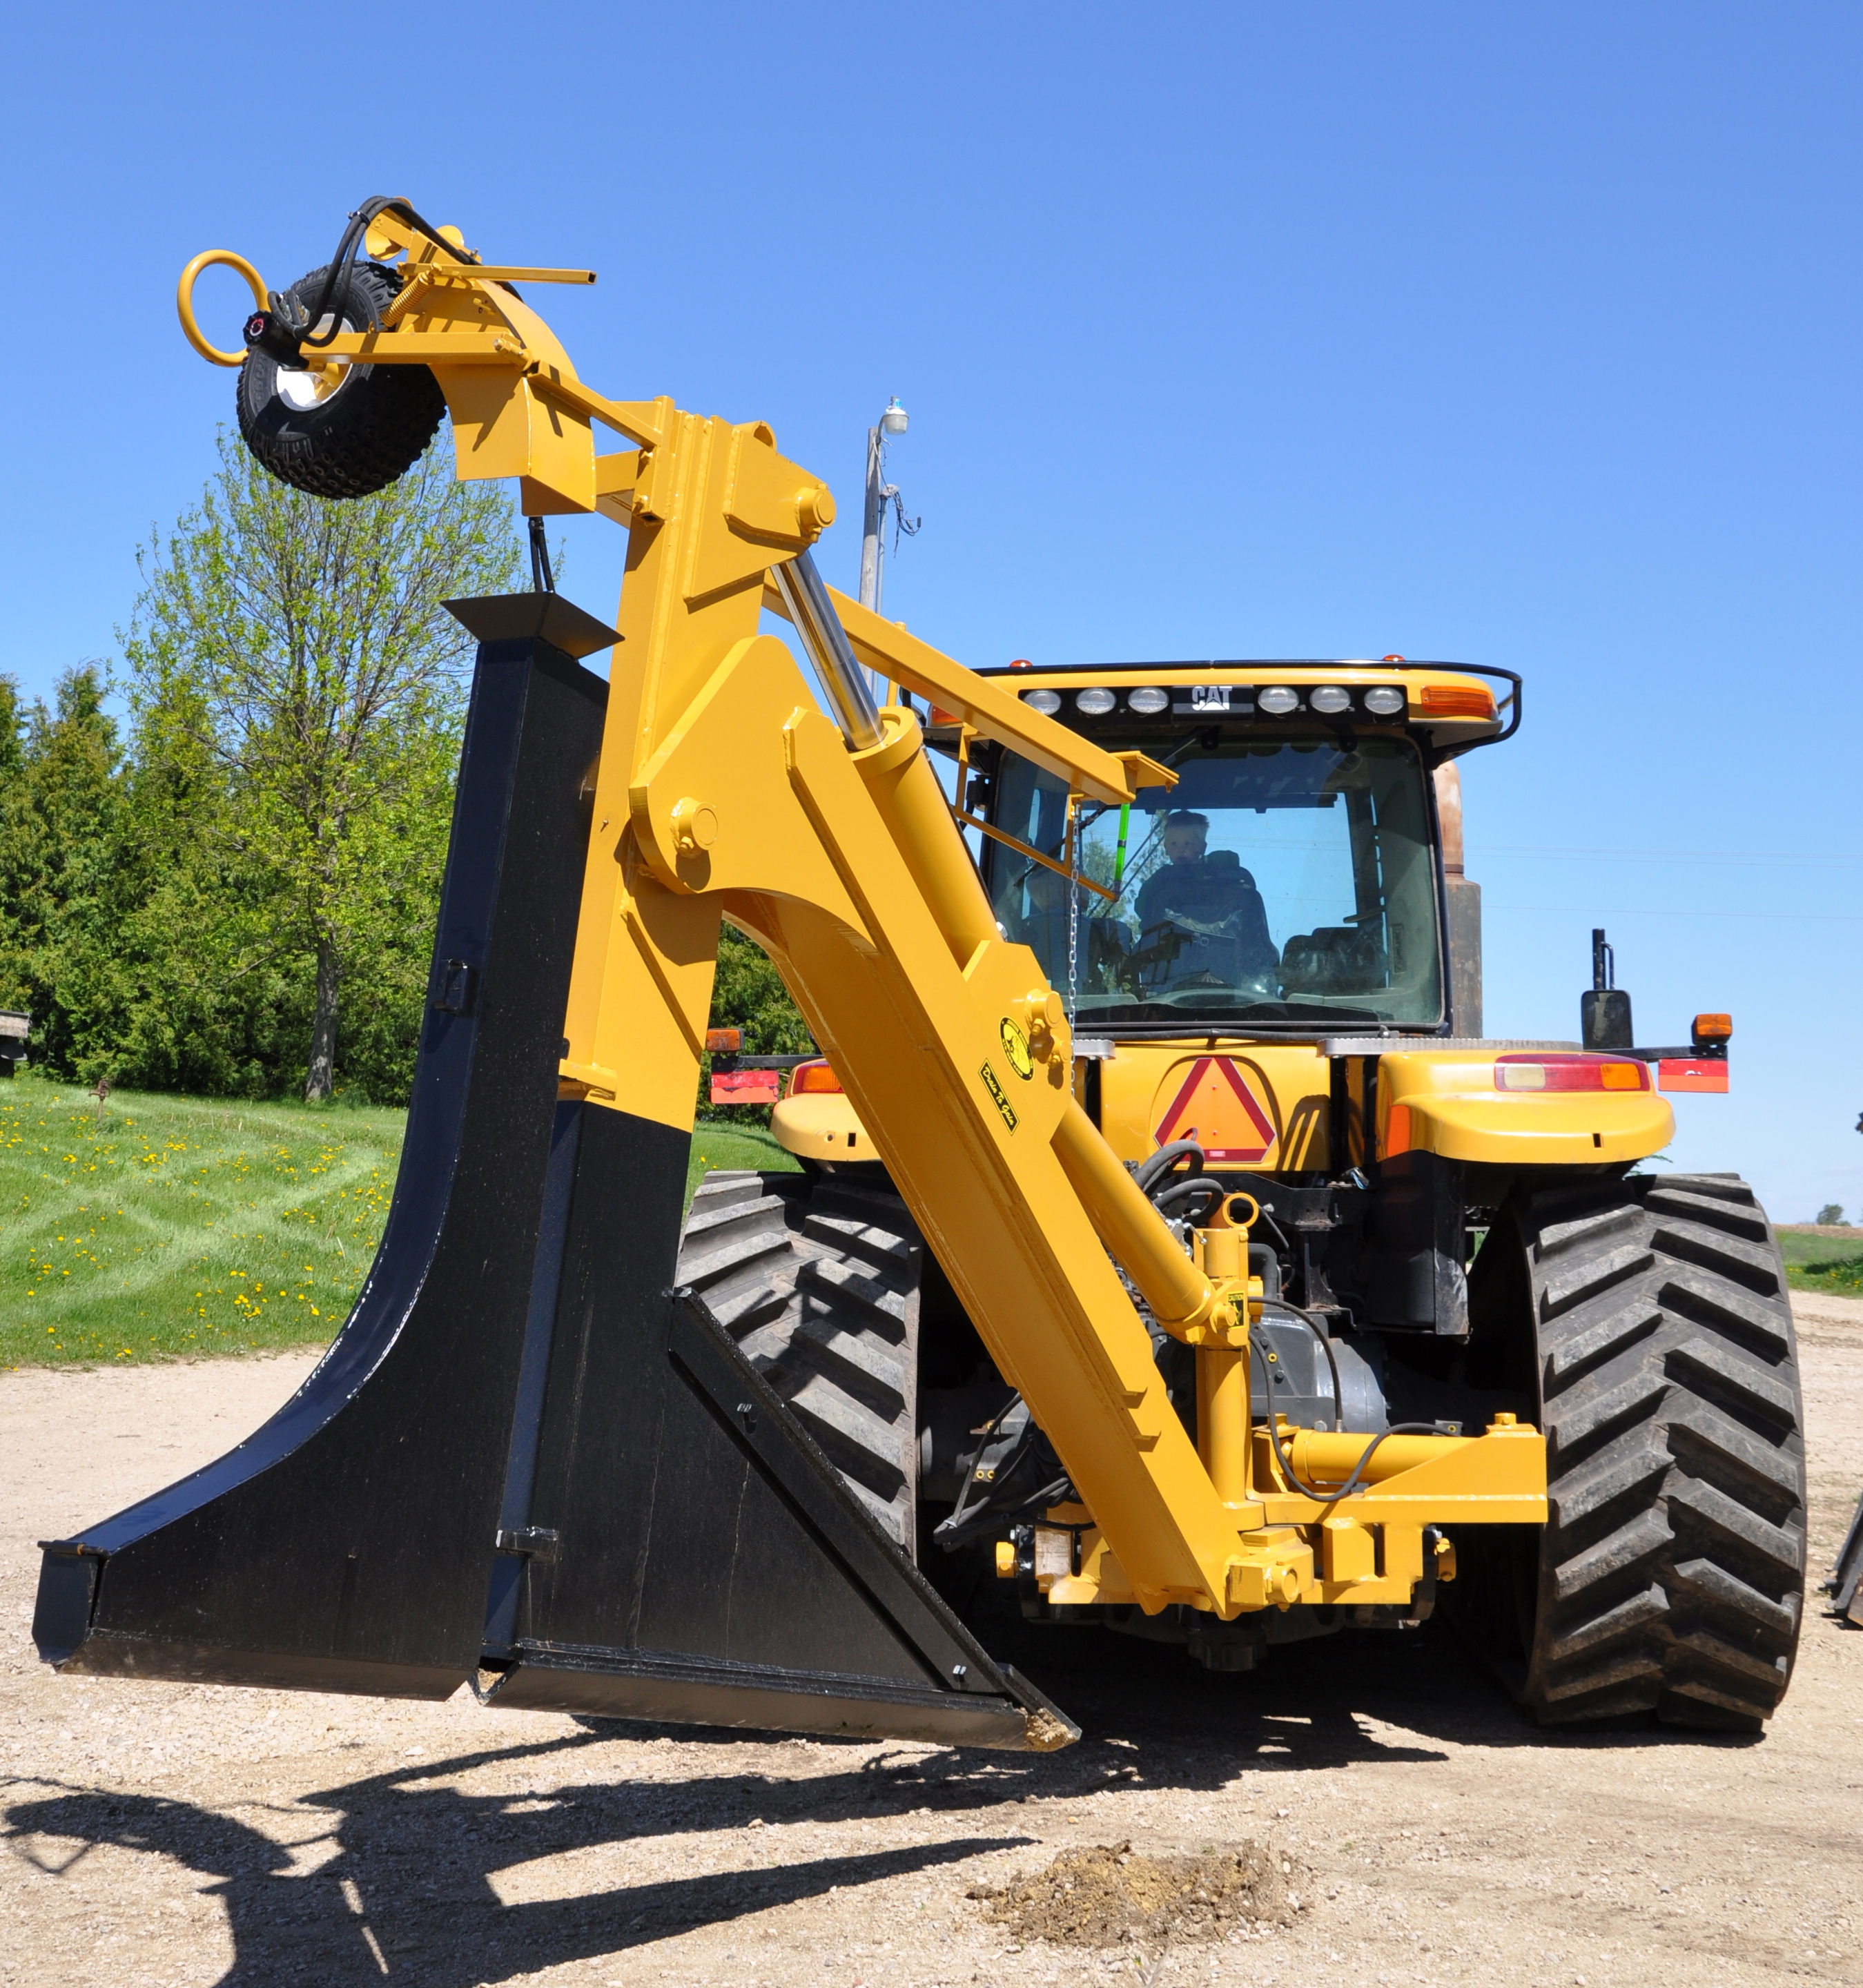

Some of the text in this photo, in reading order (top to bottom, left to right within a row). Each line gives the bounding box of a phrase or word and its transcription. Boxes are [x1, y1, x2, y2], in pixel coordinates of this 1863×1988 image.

[1192, 686, 1233, 710] CAT
[983, 1066, 1015, 1126] Drain To Gain
